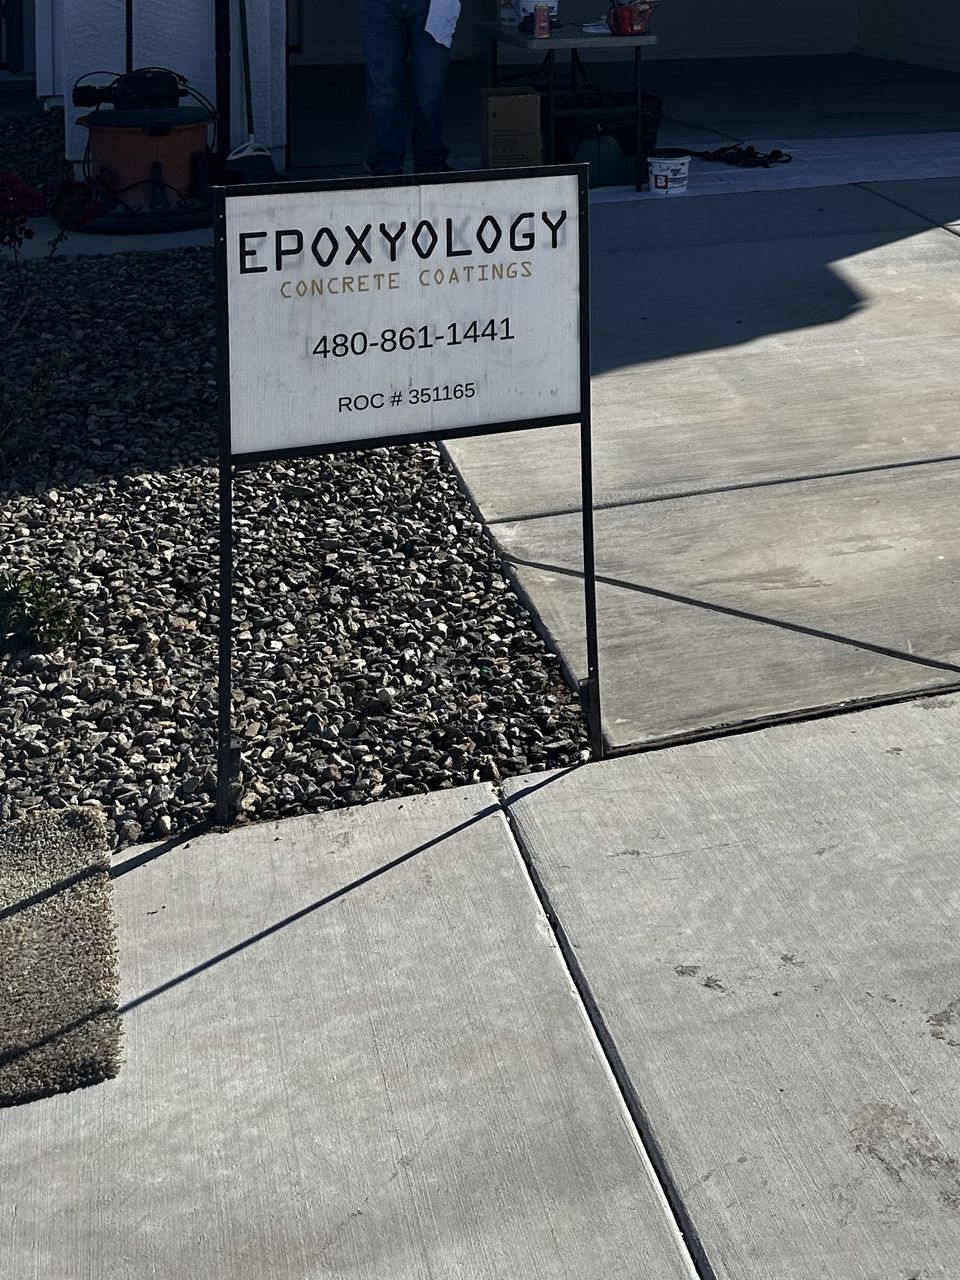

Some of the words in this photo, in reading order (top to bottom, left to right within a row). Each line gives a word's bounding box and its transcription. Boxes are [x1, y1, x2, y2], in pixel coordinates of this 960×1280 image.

[239, 210, 567, 274] EPOXYOLOGY
[280, 272, 400, 298] CONCRETE
[418, 261, 533, 287] COATINGS
[312, 317, 515, 359] 480-861-1441
[338, 392, 385, 413] ROC
[390, 390, 403, 407] #
[408, 382, 476, 405] 351165
